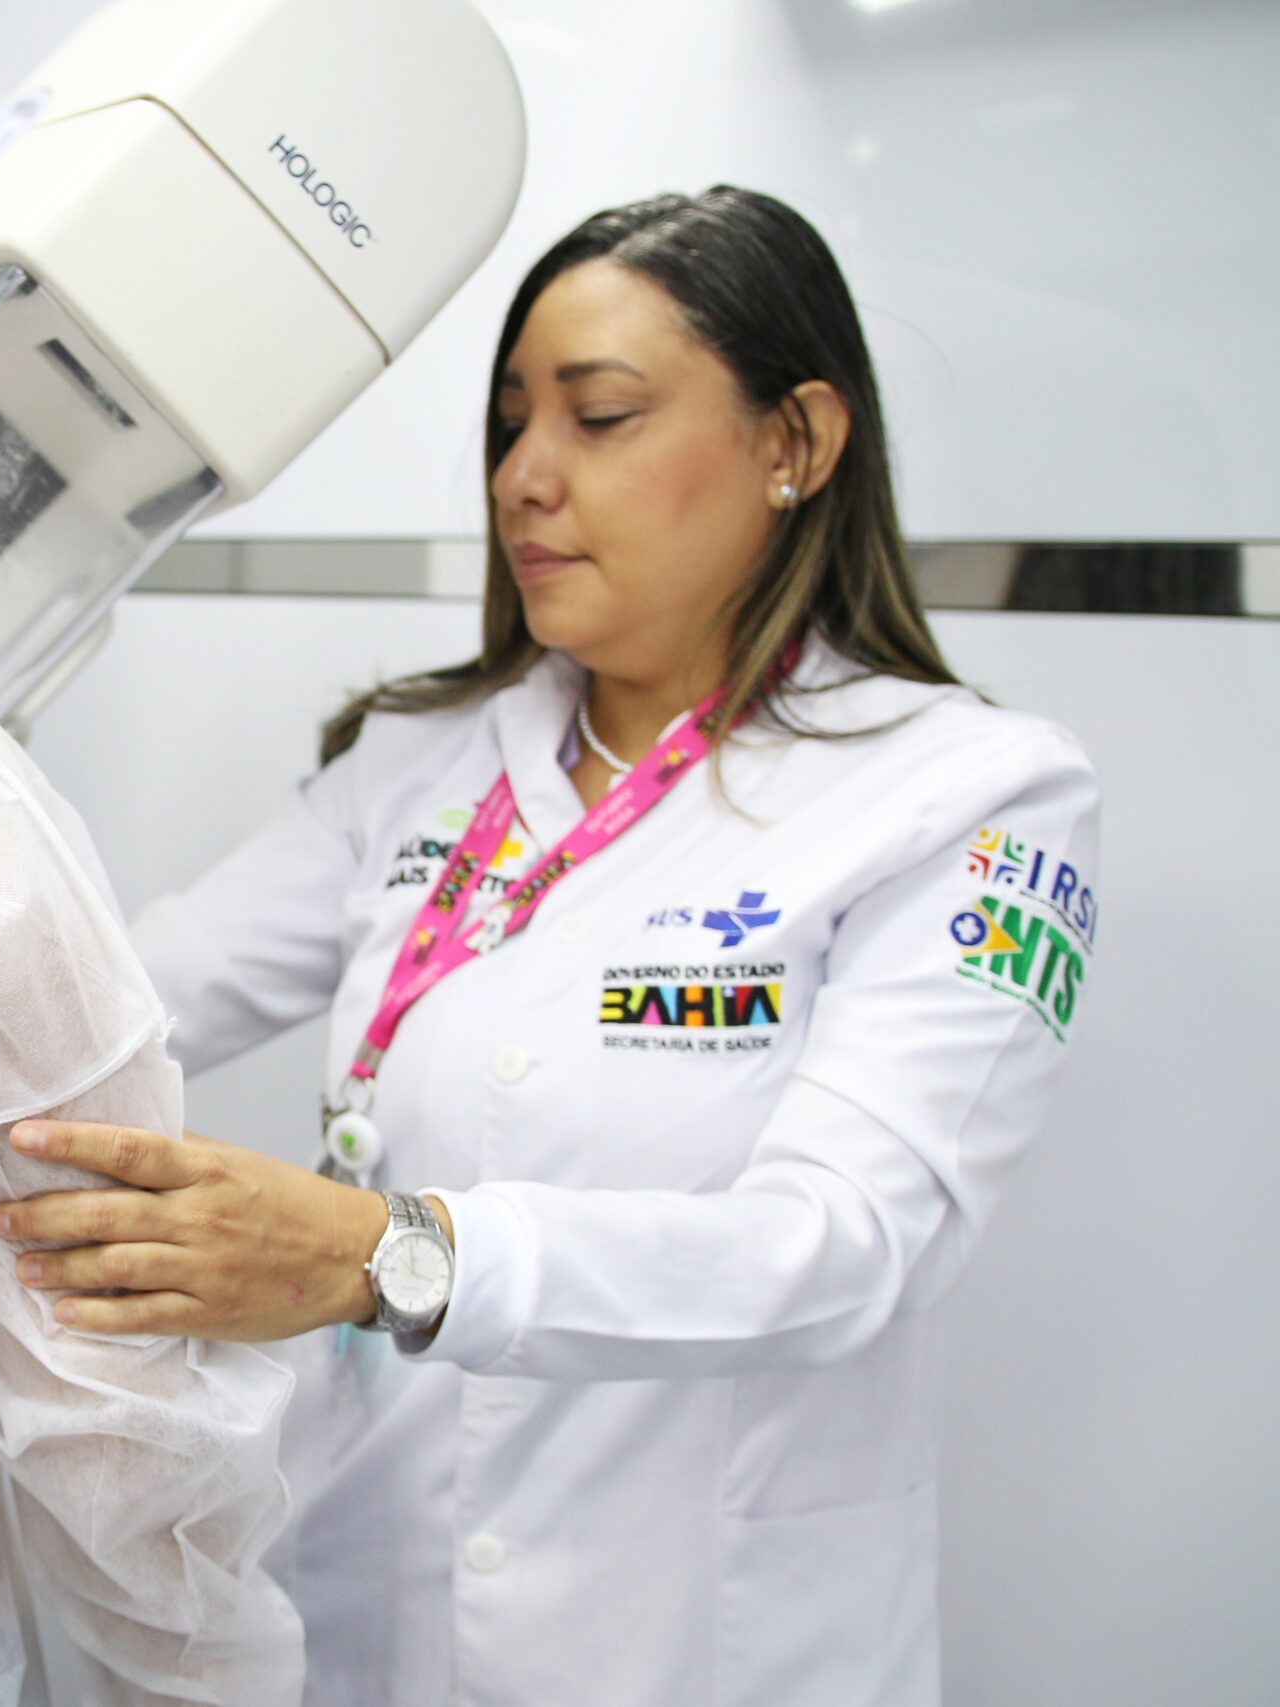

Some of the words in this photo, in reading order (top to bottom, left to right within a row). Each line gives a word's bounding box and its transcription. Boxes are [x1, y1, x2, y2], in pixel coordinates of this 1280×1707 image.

[268, 134, 372, 248] HOLOGIC
[1027, 849, 1098, 945] IRS
[603, 965, 680, 980] GOVERNO
[684, 966, 708, 979] DO
[713, 962, 786, 979] ESTADO
[599, 983, 782, 1027] BAHIA
[603, 1035, 694, 1051] SECRETARIA
[699, 1039, 719, 1053] DE
